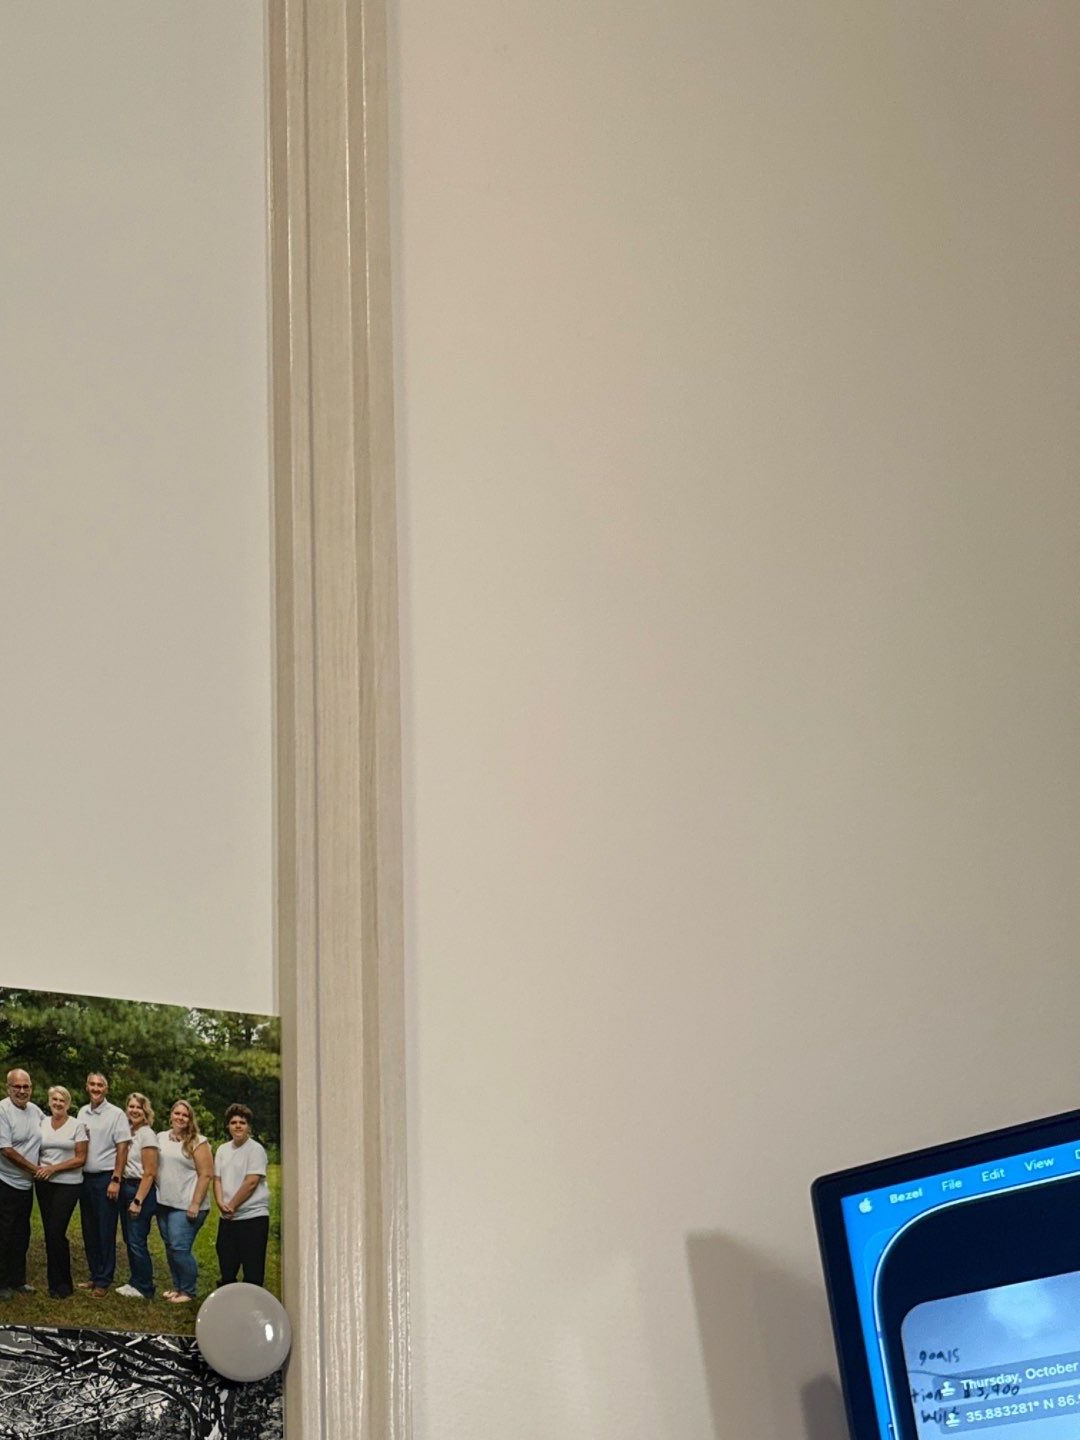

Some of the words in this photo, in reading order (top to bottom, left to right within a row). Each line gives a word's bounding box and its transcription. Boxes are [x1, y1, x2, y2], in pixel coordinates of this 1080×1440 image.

[889, 1188, 923, 1204] Bezel
[941, 1179, 963, 1192] File
[981, 1168, 1006, 1182] Edit
[1024, 1157, 1055, 1172] View
[960, 1372, 1023, 1390] Thursday,
[1025, 1361, 1079, 1380] October
[1043, 1398, 1054, 1411] N
[1057, 1394, 1080, 1407] 86.
